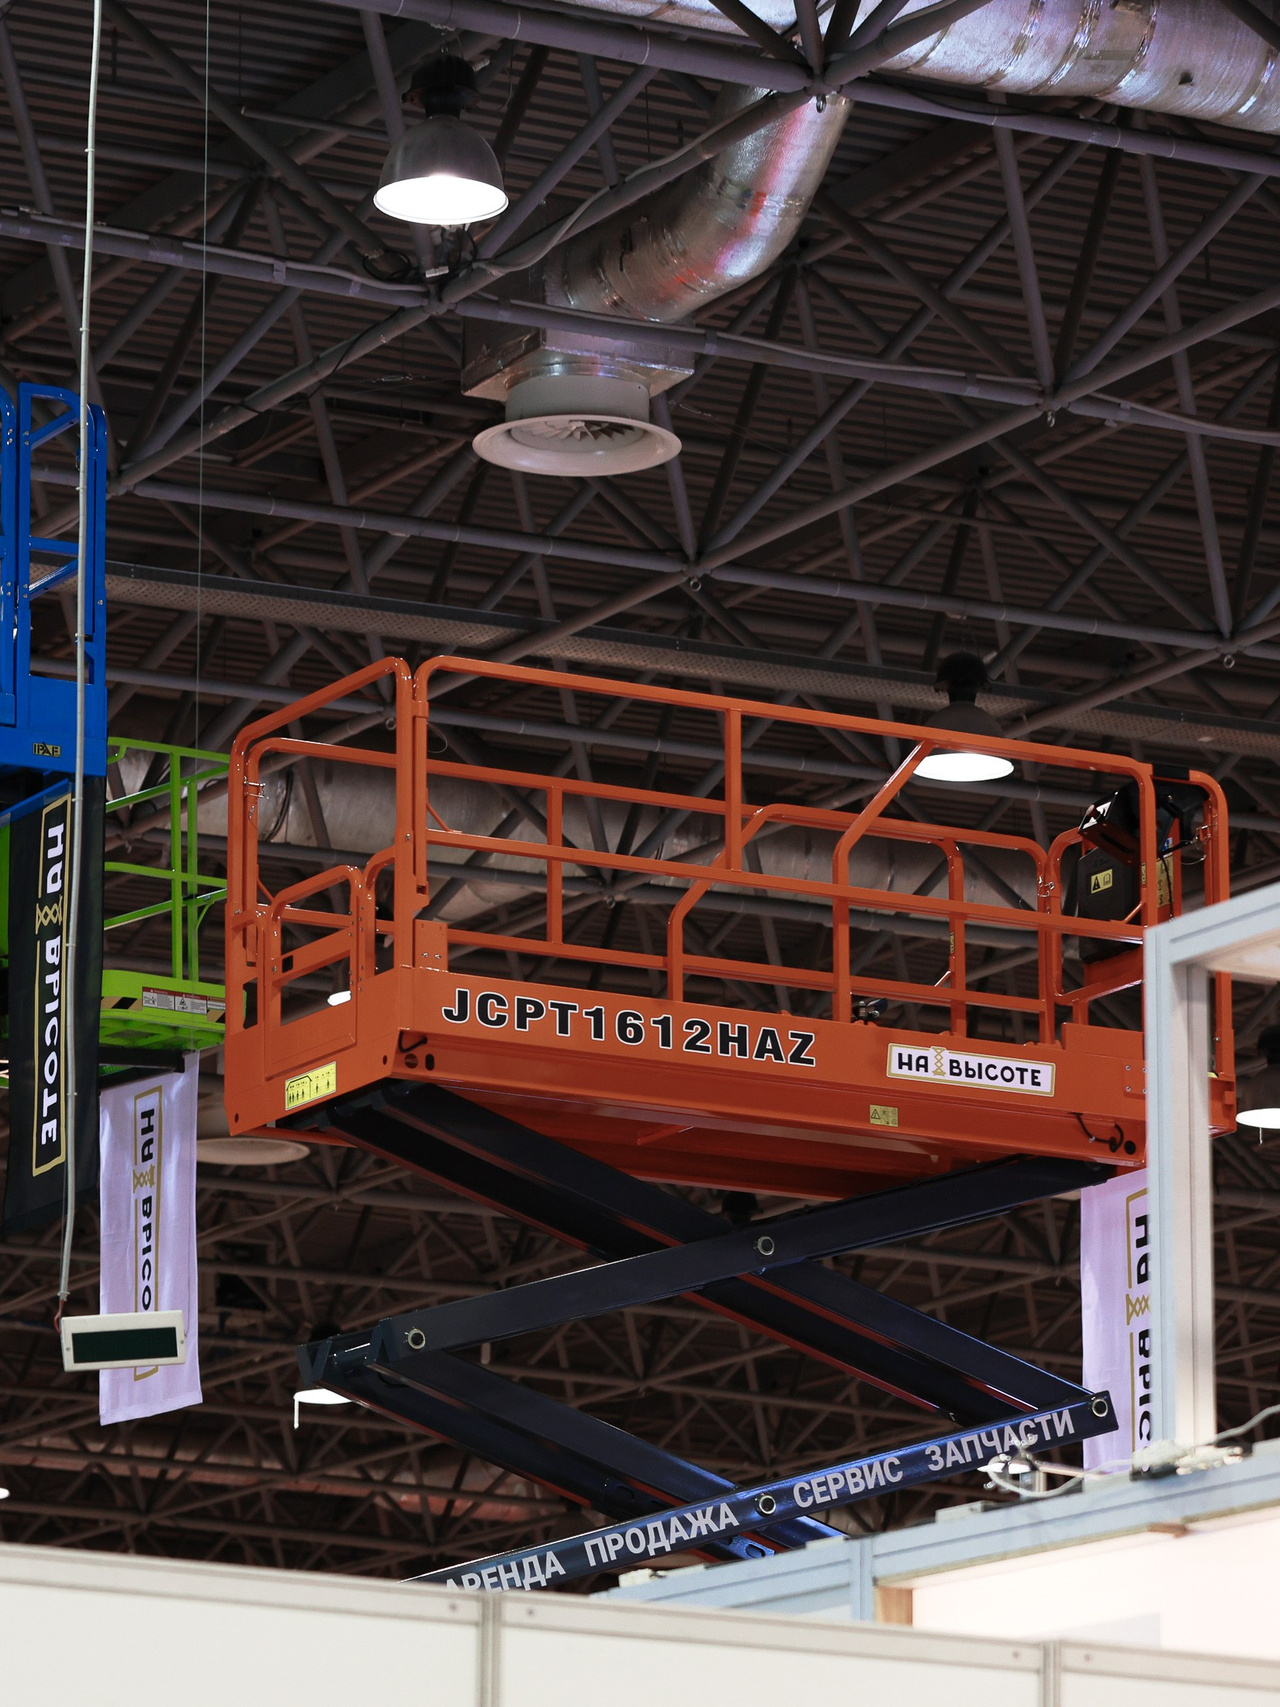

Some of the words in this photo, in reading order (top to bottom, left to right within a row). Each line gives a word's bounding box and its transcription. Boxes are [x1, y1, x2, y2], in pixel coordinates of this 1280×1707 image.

[442, 987, 816, 1067] JCPT1612HAZ
[897, 1052, 929, 1073] НА
[949, 1058, 1042, 1087] ВЫСОТЕ
[583, 1503, 739, 1567] ПРОДАЖА
[793, 1457, 903, 1508] СЕРВИС
[925, 1409, 1075, 1471] ЗАПЧАСТИ
